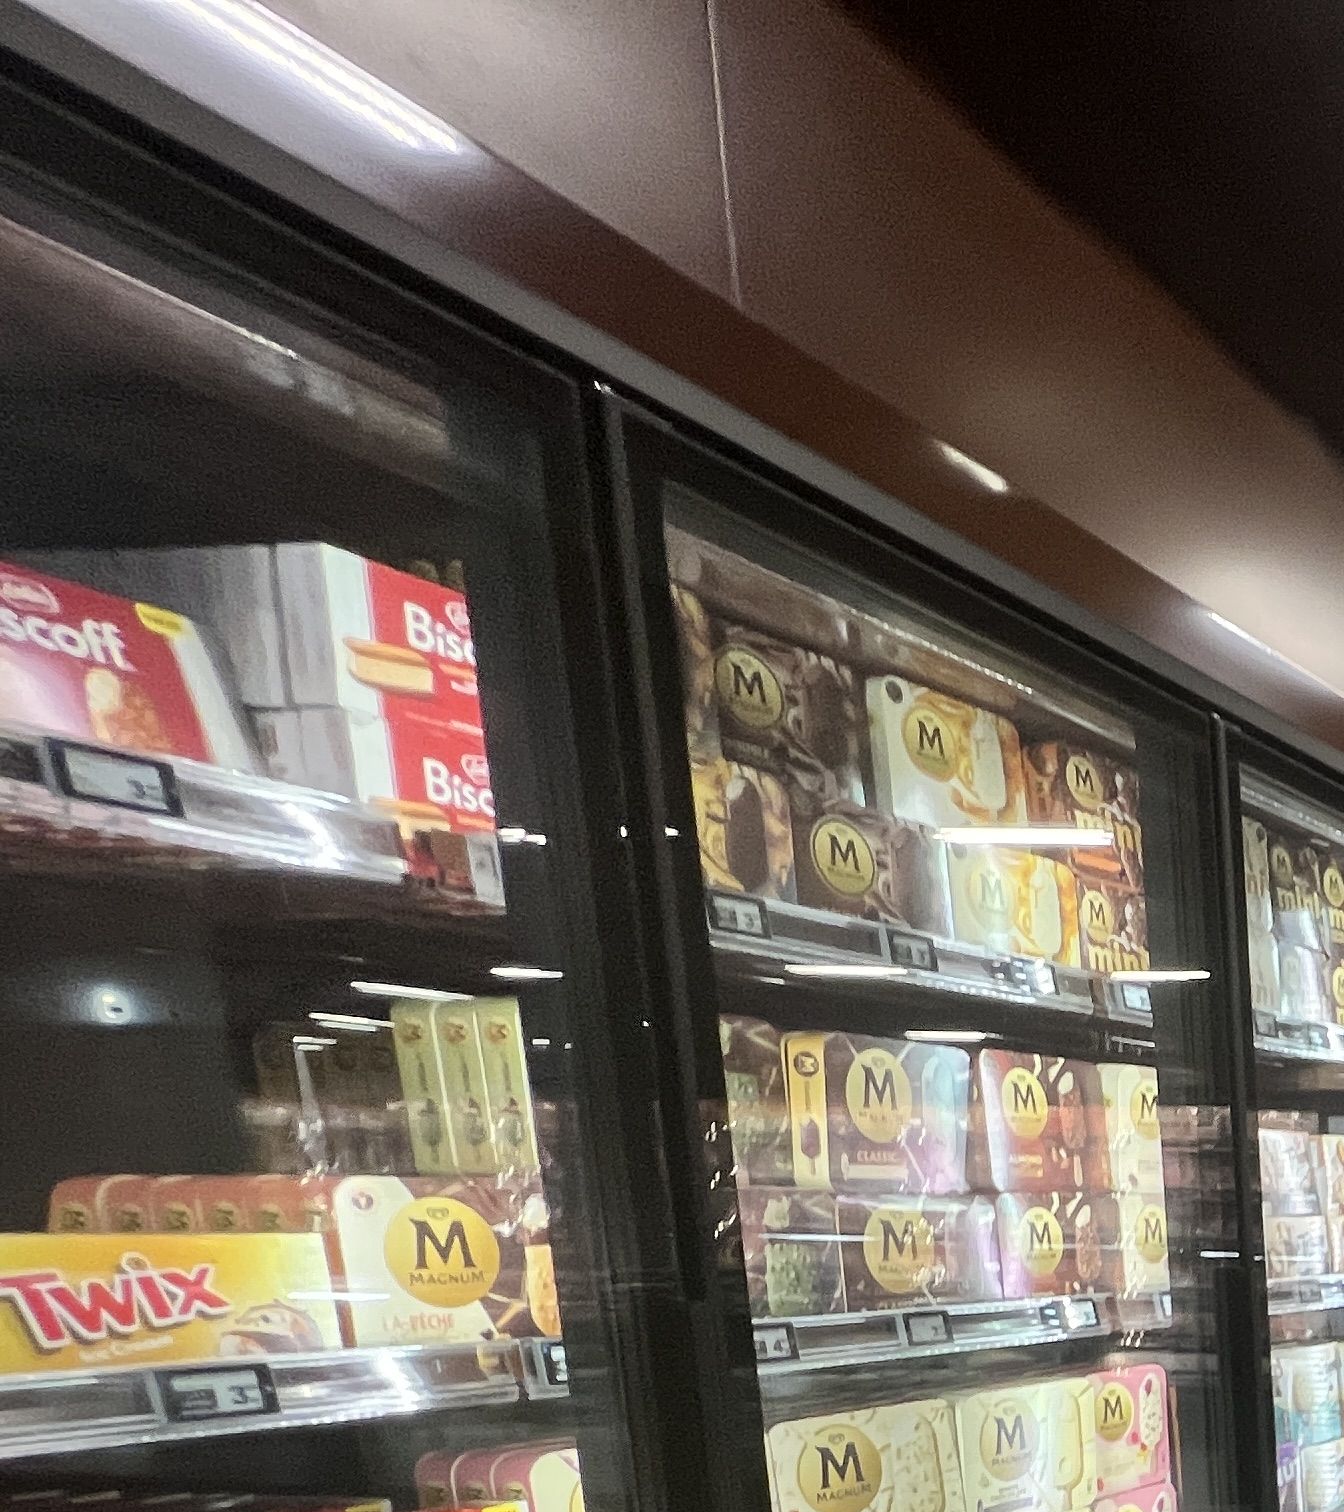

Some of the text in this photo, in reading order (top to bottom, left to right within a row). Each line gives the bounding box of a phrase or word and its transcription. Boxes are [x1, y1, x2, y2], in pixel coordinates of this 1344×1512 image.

[0, 607, 127, 672] scoff
[403, 600, 478, 667] Bisc
[731, 661, 767, 704] M
[917, 719, 946, 759] M
[422, 756, 497, 818] Bisc
[1074, 764, 1096, 792] M
[828, 832, 861, 873] M
[1089, 900, 1107, 926] M
[861, 1063, 898, 1111] M
[1012, 1080, 1038, 1115] M
[409, 1216, 477, 1270] M
[880, 1217, 918, 1262] M
[1028, 1219, 1053, 1251] M
[1144, 1217, 1163, 1244] M
[410, 1270, 485, 1287] MAGNUM
[1102, 1395, 1124, 1424] M
[994, 1414, 1026, 1456] M
[815, 1441, 865, 1490] M
[816, 1482, 872, 1504] MAGNUM
